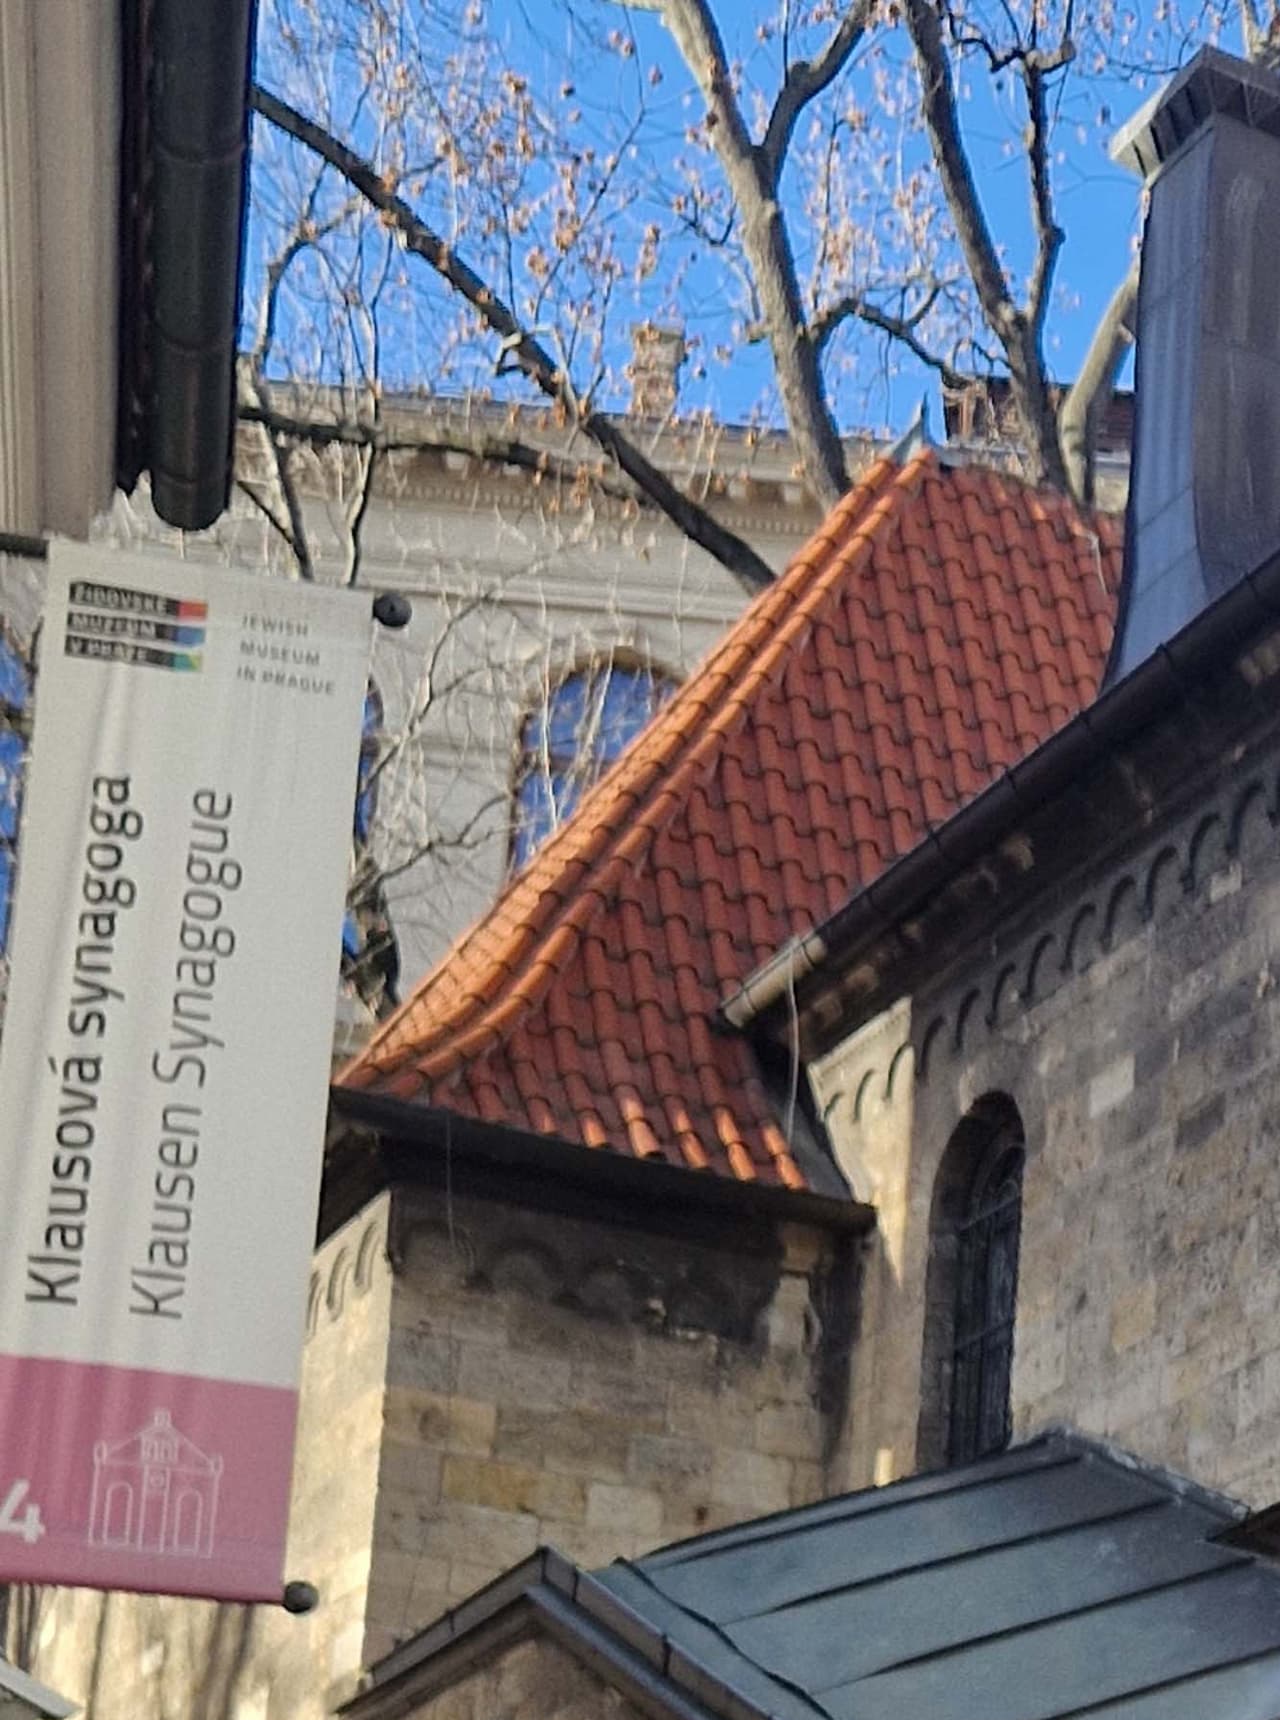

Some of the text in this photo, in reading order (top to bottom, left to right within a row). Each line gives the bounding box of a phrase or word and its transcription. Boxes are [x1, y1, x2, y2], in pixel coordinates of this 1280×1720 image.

[242, 614, 310, 637] JEWISH
[240, 639, 321, 667] MUSEUM
[236, 664, 337, 696] IN PRAGUE
[25, 776, 143, 1306] Klausová synagoga
[129, 787, 243, 1319] Klausen Synagogue
[0, 1479, 45, 1544] 4
